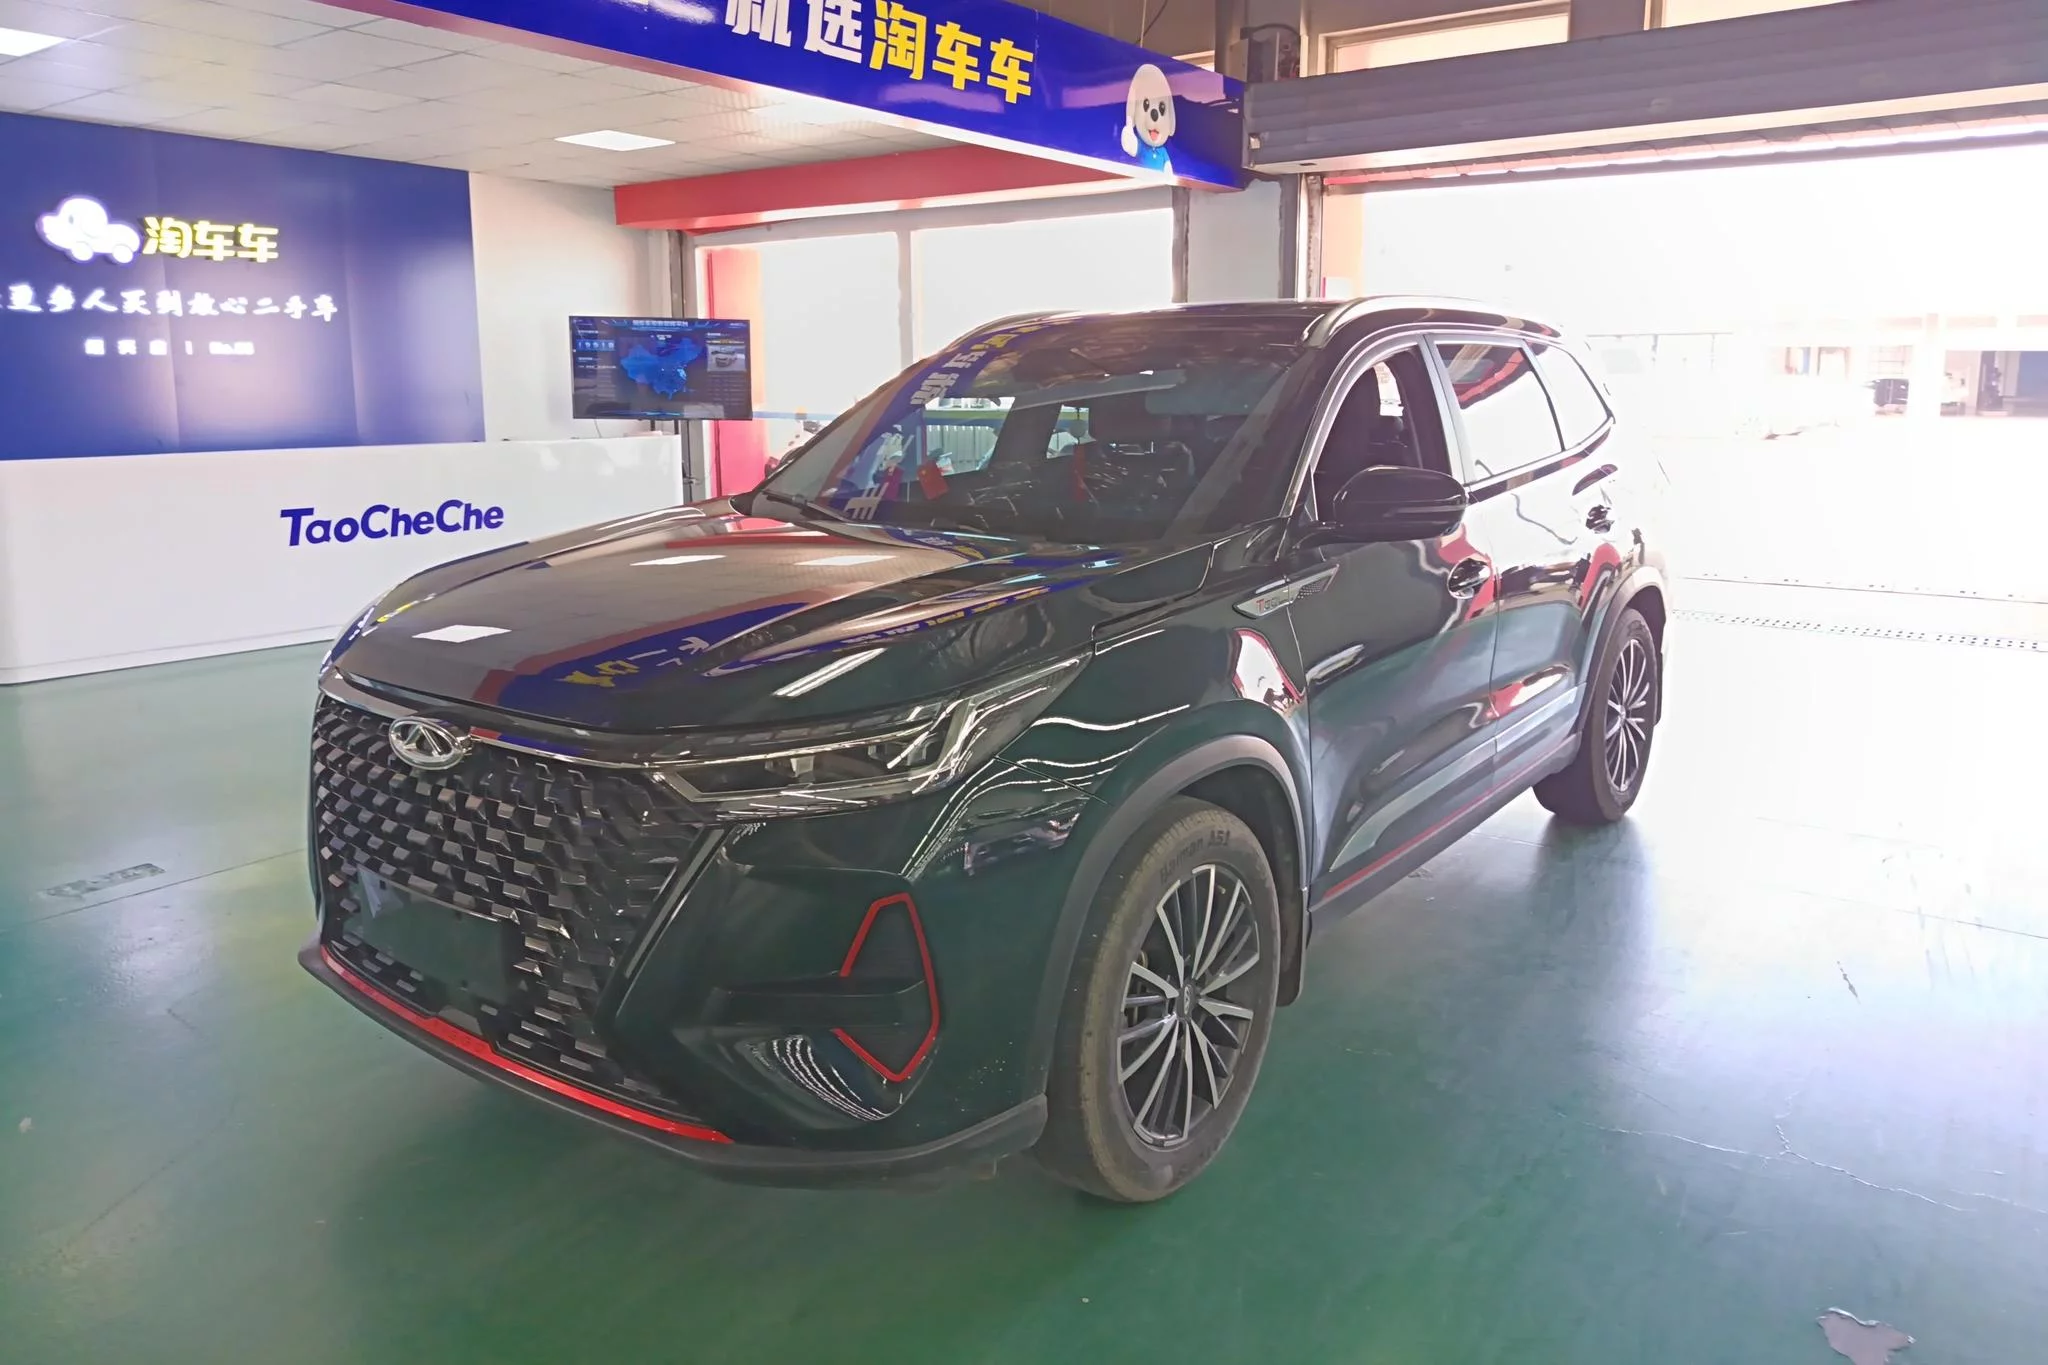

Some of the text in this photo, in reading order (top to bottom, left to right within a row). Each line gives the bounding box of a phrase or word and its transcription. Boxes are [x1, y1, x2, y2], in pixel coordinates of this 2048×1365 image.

[143, 216, 280, 263] 淘车车
[0, 284, 338, 322] 更多人买到放心二手车
[280, 499, 504, 547] TaoCheChe
